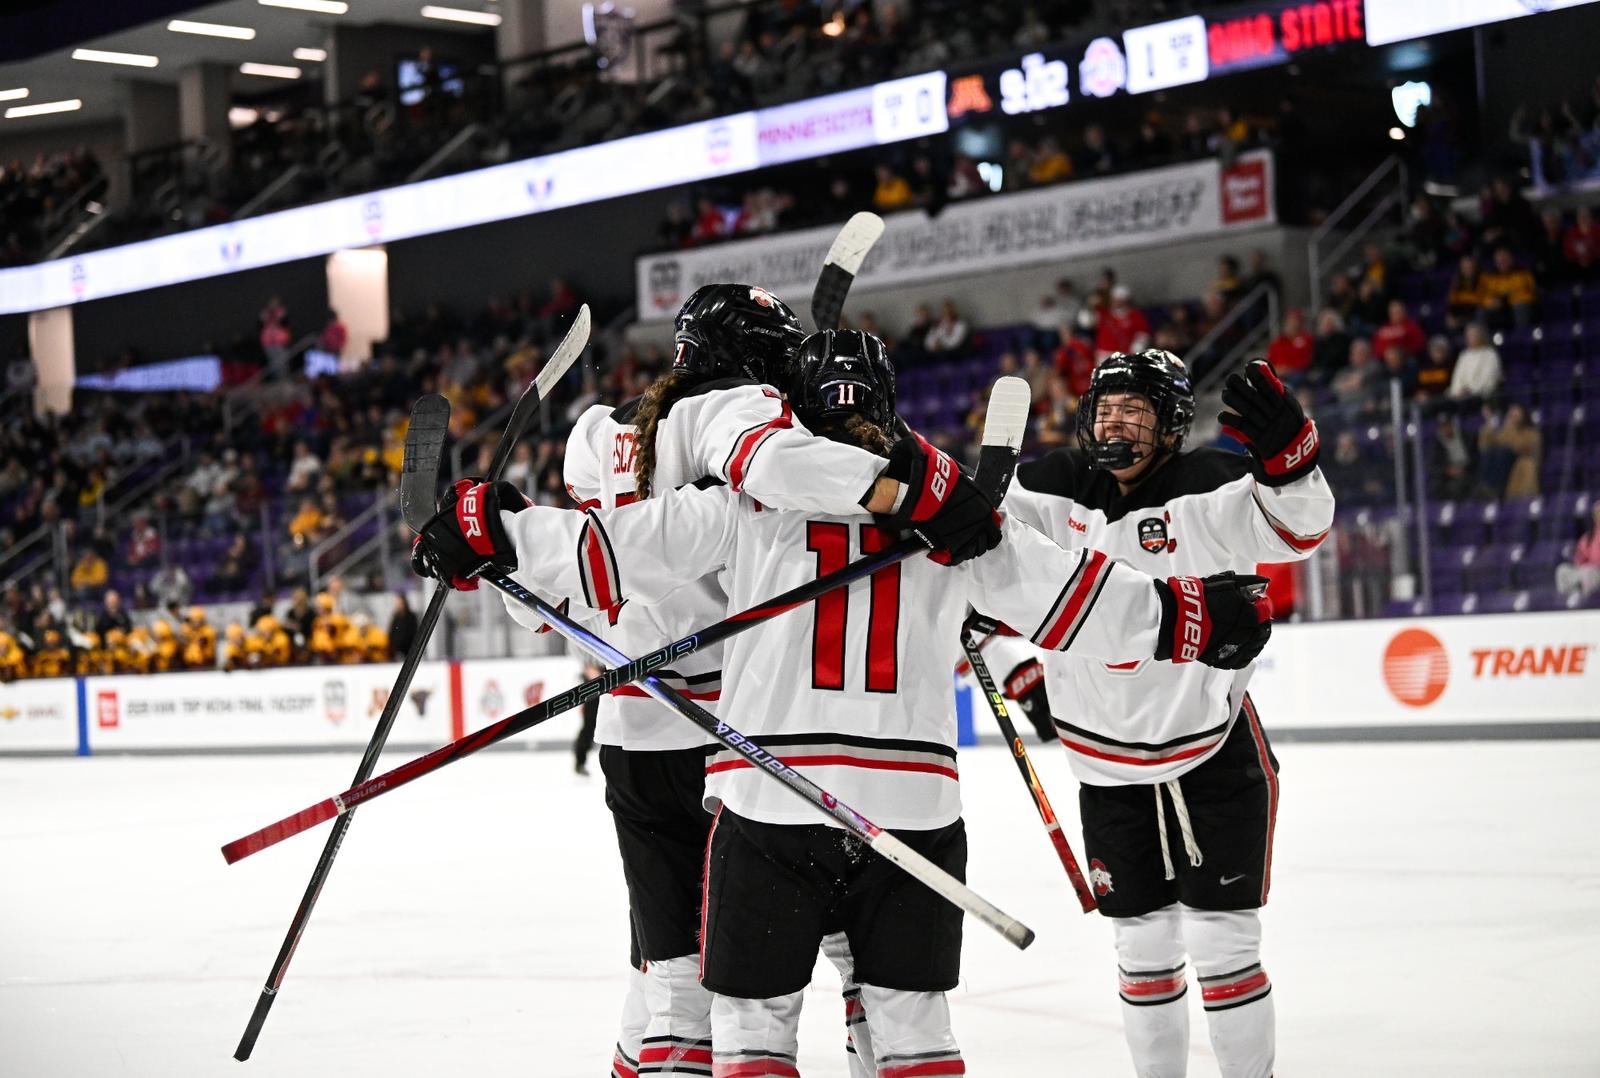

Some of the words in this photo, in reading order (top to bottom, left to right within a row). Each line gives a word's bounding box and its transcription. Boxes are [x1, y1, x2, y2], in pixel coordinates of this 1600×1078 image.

[837, 384, 855, 405] 11
[806, 520, 902, 694] 11
[546, 634, 699, 719] BAUER
[969, 650, 1008, 718] BAUER
[1471, 646, 1589, 677] TRANE
[724, 731, 800, 784] BAUER
